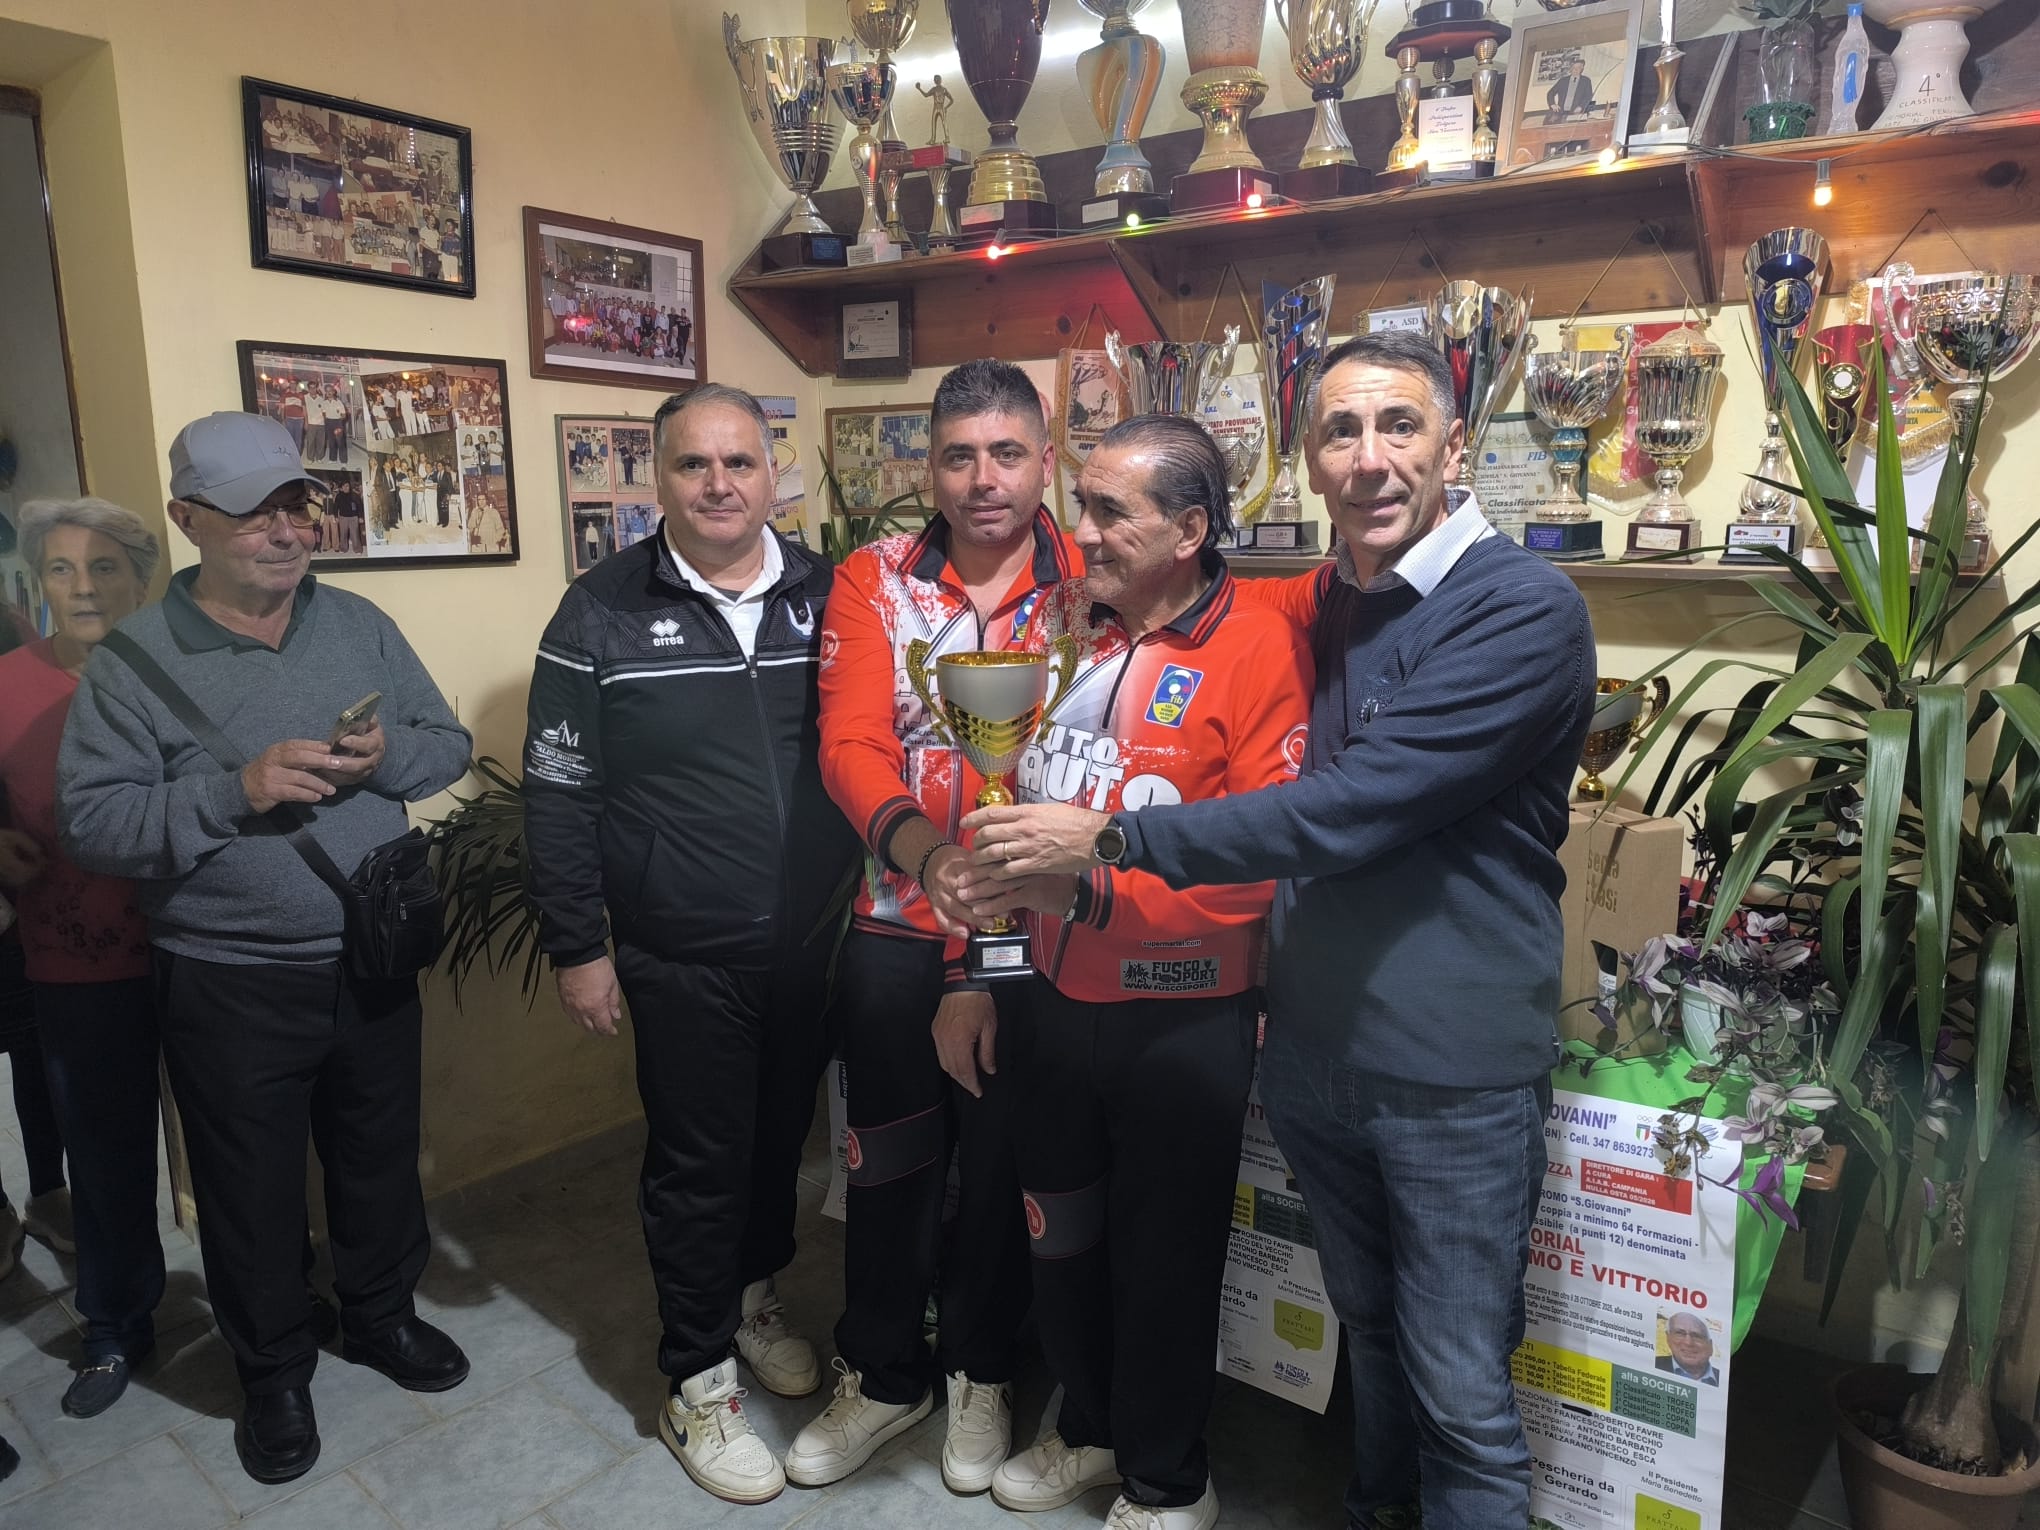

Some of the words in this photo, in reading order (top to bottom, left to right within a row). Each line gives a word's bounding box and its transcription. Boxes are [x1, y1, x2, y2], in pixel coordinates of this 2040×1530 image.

[1527, 451, 1548, 461] FIB
[652, 635, 685, 647] errea
[1569, 1132, 1590, 1147] Cell.
[1593, 1137, 1611, 1149] 347
[1613, 1139, 1655, 1159] 8639273
[1585, 1160, 1625, 1175] DIRETTORE
[1626, 1169, 1634, 1177] DI
[1635, 1171, 1656, 1182] GARA
[1592, 1170, 1612, 1180] CURA
[1585, 1184, 1609, 1195] NULLA
[1610, 1189, 1629, 1199] OSTA
[1611, 1182, 1648, 1196] CAMPANIA
[1277, 1196, 1309, 1214] SOCIET
[1540, 1204, 1572, 1221] coppia
[1584, 1212, 1619, 1229] minimo
[1621, 1222, 1634, 1233] 64
[1636, 1225, 1692, 1248] Formazioni
[1240, 1230, 1273, 1246] ROBERTO
[1273, 1241, 1295, 1254] FAVRE
[1251, 1240, 1264, 1250] DEL
[1264, 1245, 1295, 1261] VECCHIO
[1569, 1223, 1579, 1236] (a
[1581, 1226, 1607, 1242] punti
[1609, 1233, 1625, 1248] 12)
[1627, 1239, 1687, 1261] denominata
[1229, 1248, 1269, 1268] FRANCESCO
[1270, 1263, 1289, 1275] ESCA
[1242, 1261, 1275, 1278] VINCENZO
[1258, 1249, 1290, 1267] BARBATO
[1245, 1289, 1259, 1302] da
[1570, 1260, 1585, 1278] E
[1592, 1263, 1709, 1310] VITTORIO
[1580, 1296, 1602, 1309] OTTOBRE
[1552, 1361, 1577, 1375] Tabella
[1577, 1368, 1607, 1385] Federale
[1552, 1369, 1577, 1384] Tabella
[1577, 1377, 1607, 1392] Federale
[1620, 1371, 1639, 1384] alla
[1552, 1377, 1577, 1391] Tabella
[1577, 1385, 1607, 1399] Federale
[1552, 1385, 1577, 1400] Tabella
[1577, 1393, 1607, 1408] Federale
[1623, 1383, 1662, 1402] Classificato
[1666, 1395, 1696, 1411] TROFEO
[1516, 1388, 1560, 1408] NAZIONALE
[1594, 1412, 1635, 1431] ROBERTO
[1636, 1425, 1665, 1441] FAVRE
[1623, 1391, 1662, 1410] Classificato
[1666, 1403, 1696, 1419] TROFEO
[1623, 1399, 1661, 1418] Classificato
[1665, 1412, 1691, 1427] COPPA
[1554, 1407, 1606, 1430] FRANCESCO
[1606, 1421, 1624, 1435] DEL
[1625, 1428, 1664, 1449] VECCHIO
[1623, 1407, 1661, 1426] Classificato
[1665, 1420, 1691, 1435] COPPA
[1576, 1424, 1614, 1443] ANTONIO
[1615, 1437, 1658, 1456] BARBATO
[1577, 1432, 1630, 1456] FRANCESCO
[1632, 1451, 1657, 1466] ESCA
[1594, 1446, 1638, 1468] VINCENZO
[1543, 1473, 1599, 1502] Gerardo
[1597, 1479, 1616, 1495] da
[1655, 1472, 1699, 1494] Presidente
